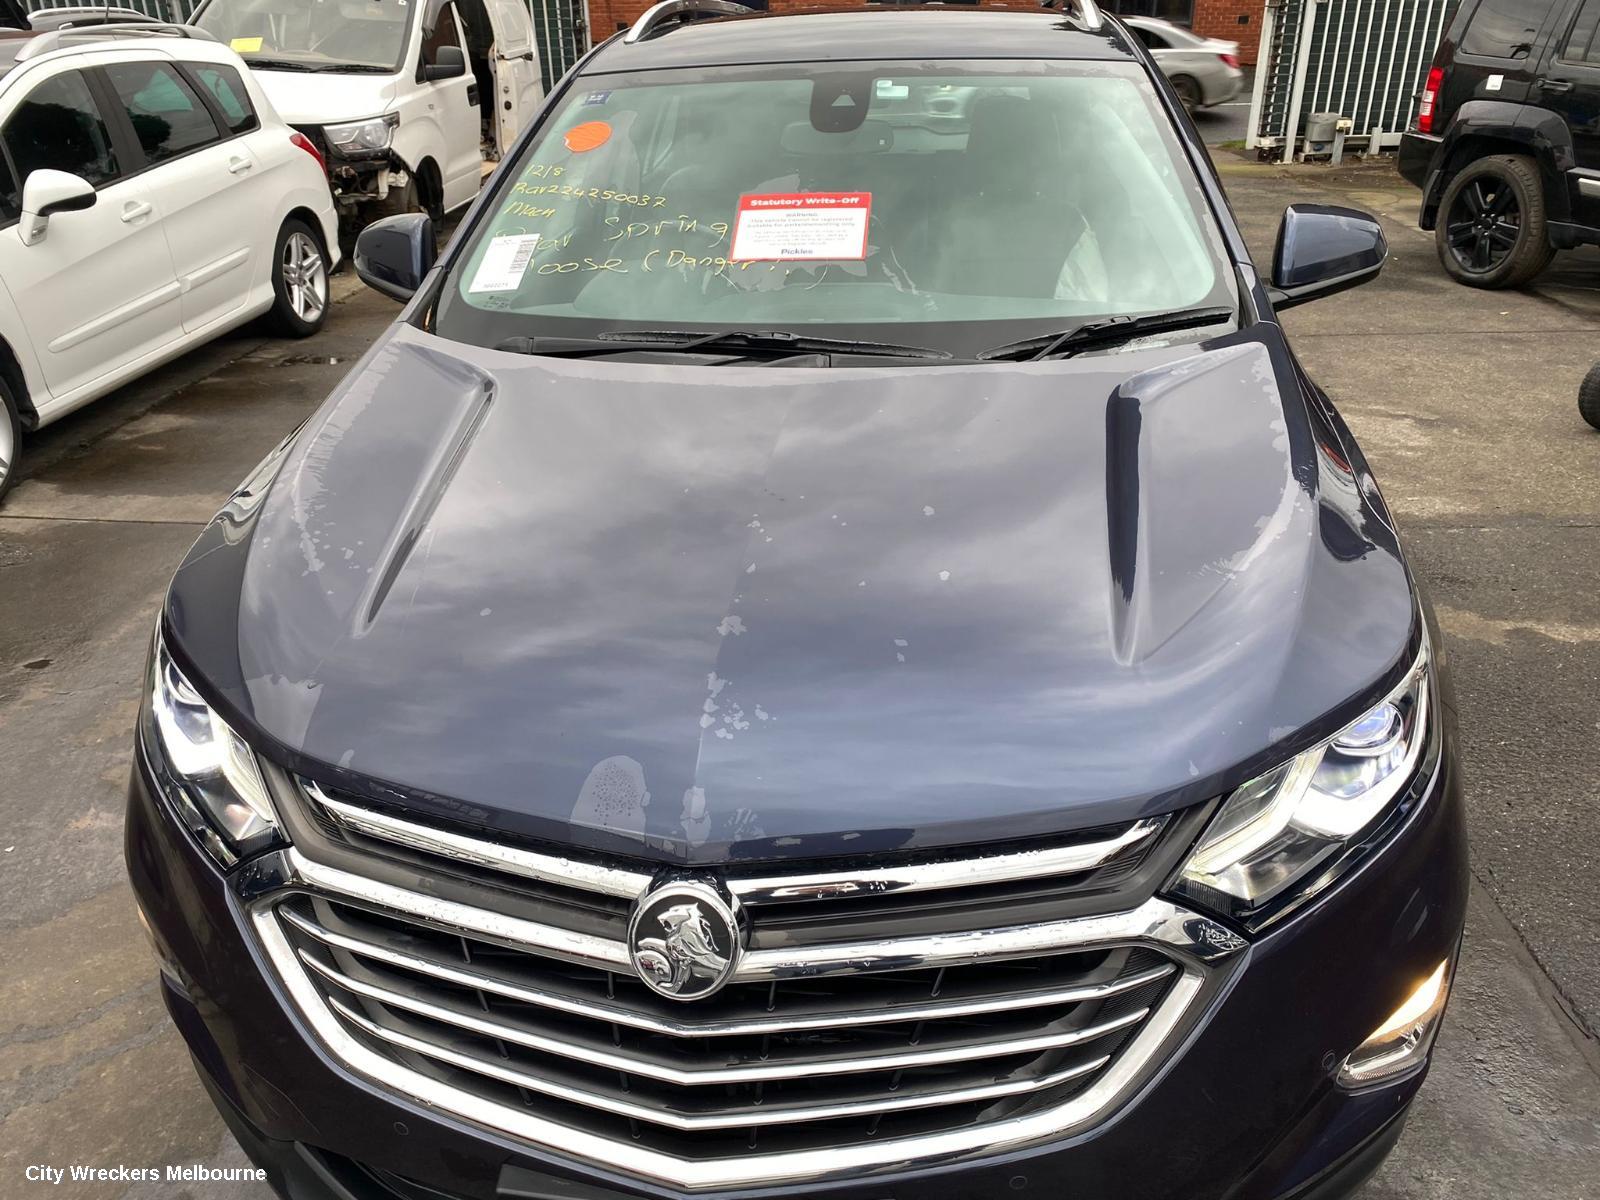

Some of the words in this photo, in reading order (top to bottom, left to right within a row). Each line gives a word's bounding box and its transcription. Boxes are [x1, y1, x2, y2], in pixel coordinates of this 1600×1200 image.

[750, 198, 803, 207] Statutory
[805, 197, 860, 205] Write-Off
[780, 247, 813, 255] Pickles
